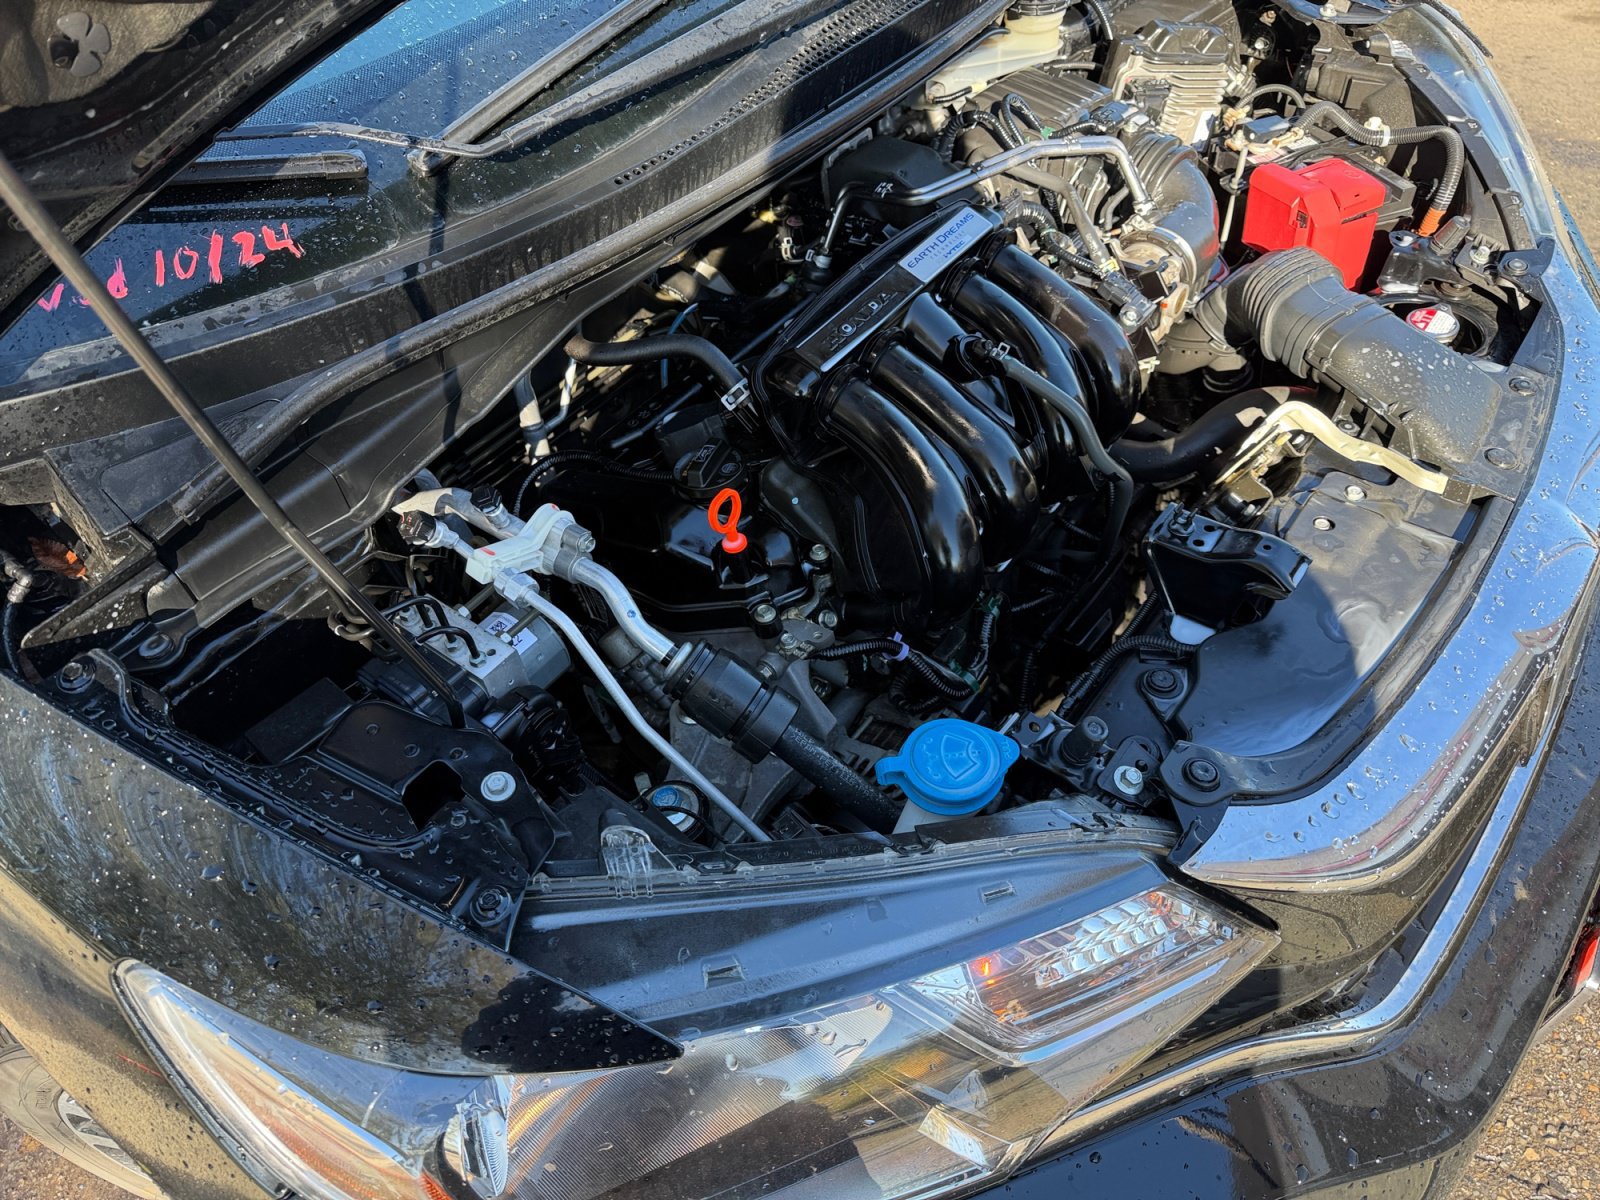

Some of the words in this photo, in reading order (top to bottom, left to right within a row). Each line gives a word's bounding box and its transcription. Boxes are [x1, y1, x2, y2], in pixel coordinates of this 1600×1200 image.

[155, 222, 306, 288] 10/24
[907, 242, 939, 269] EARTH
[936, 212, 975, 244] DREAMS
